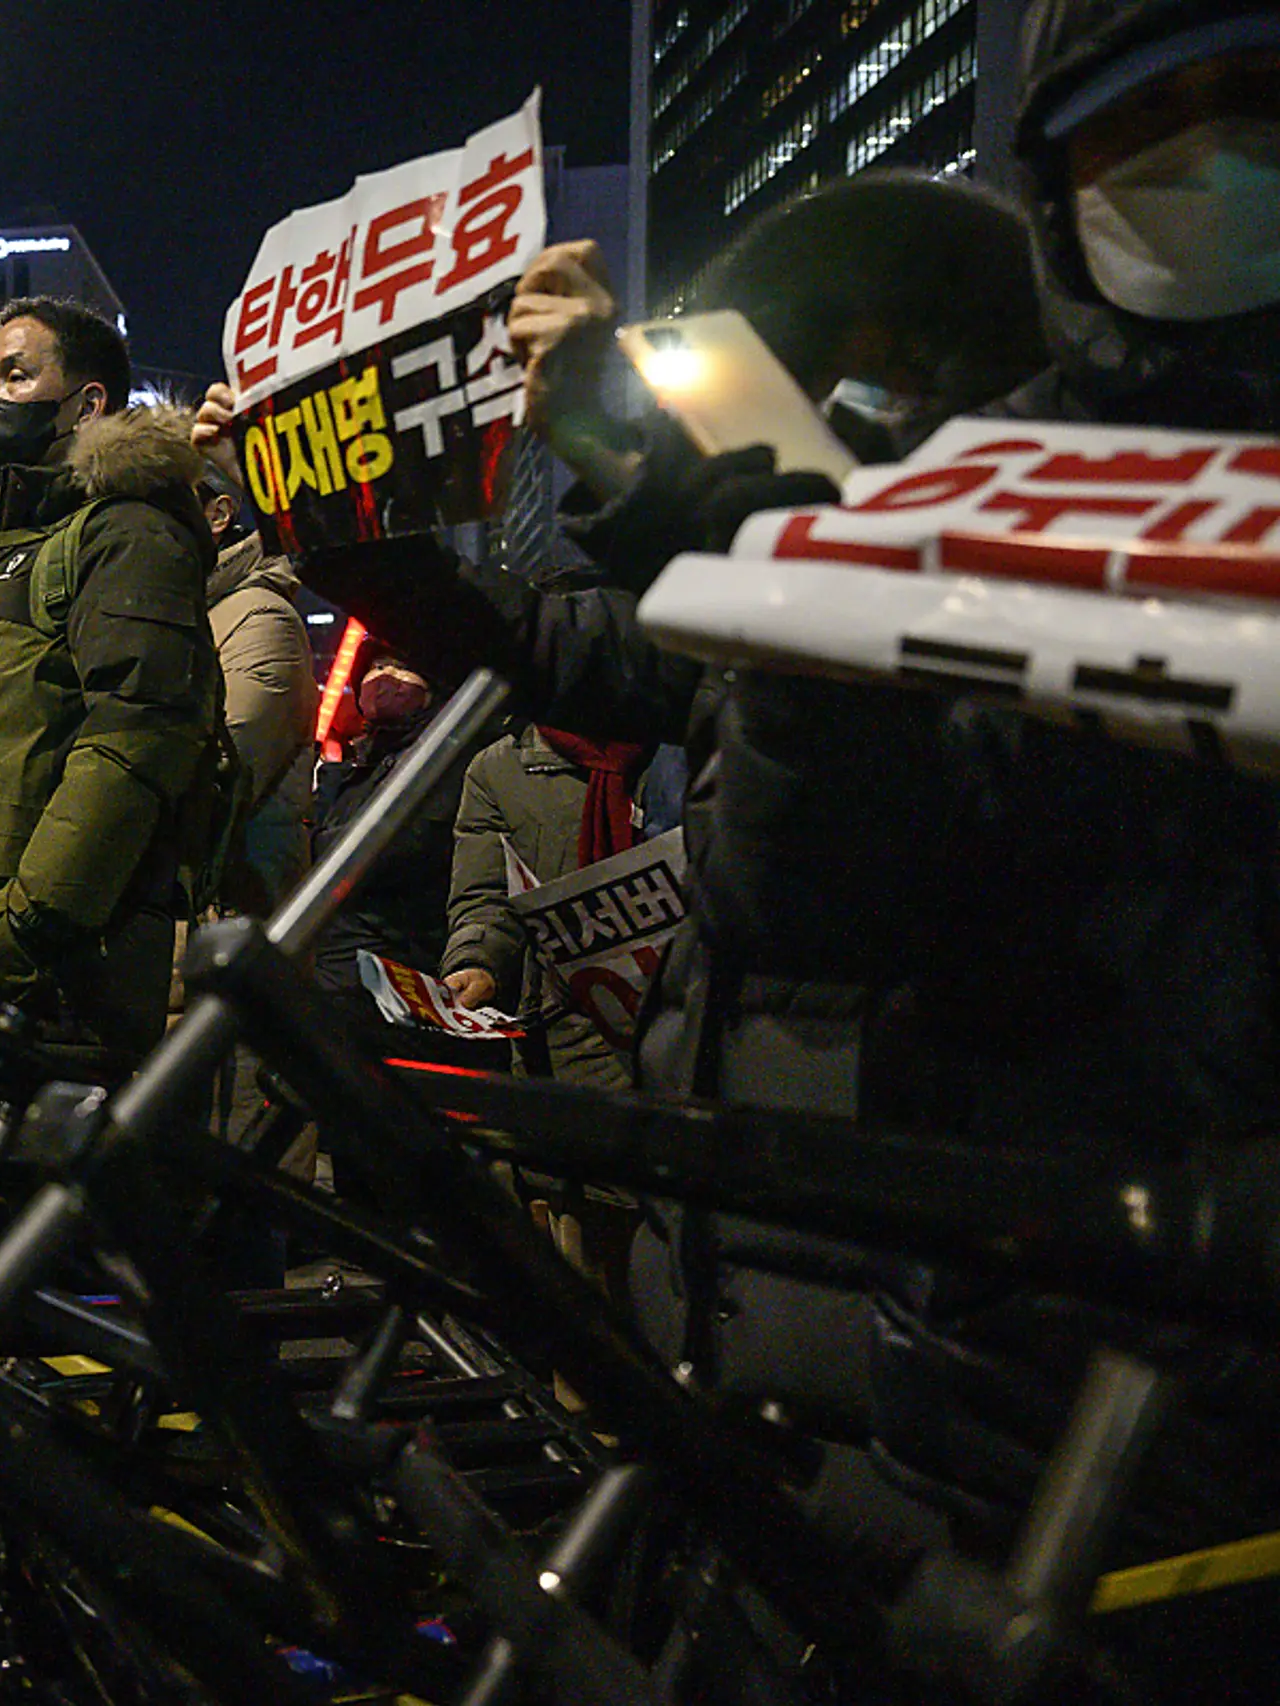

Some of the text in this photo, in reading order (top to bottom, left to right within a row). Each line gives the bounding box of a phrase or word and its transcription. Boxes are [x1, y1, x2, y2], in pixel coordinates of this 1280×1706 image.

[233, 145, 535, 391] 탄핵무효
[244, 311, 528, 515] 이재명 구속
